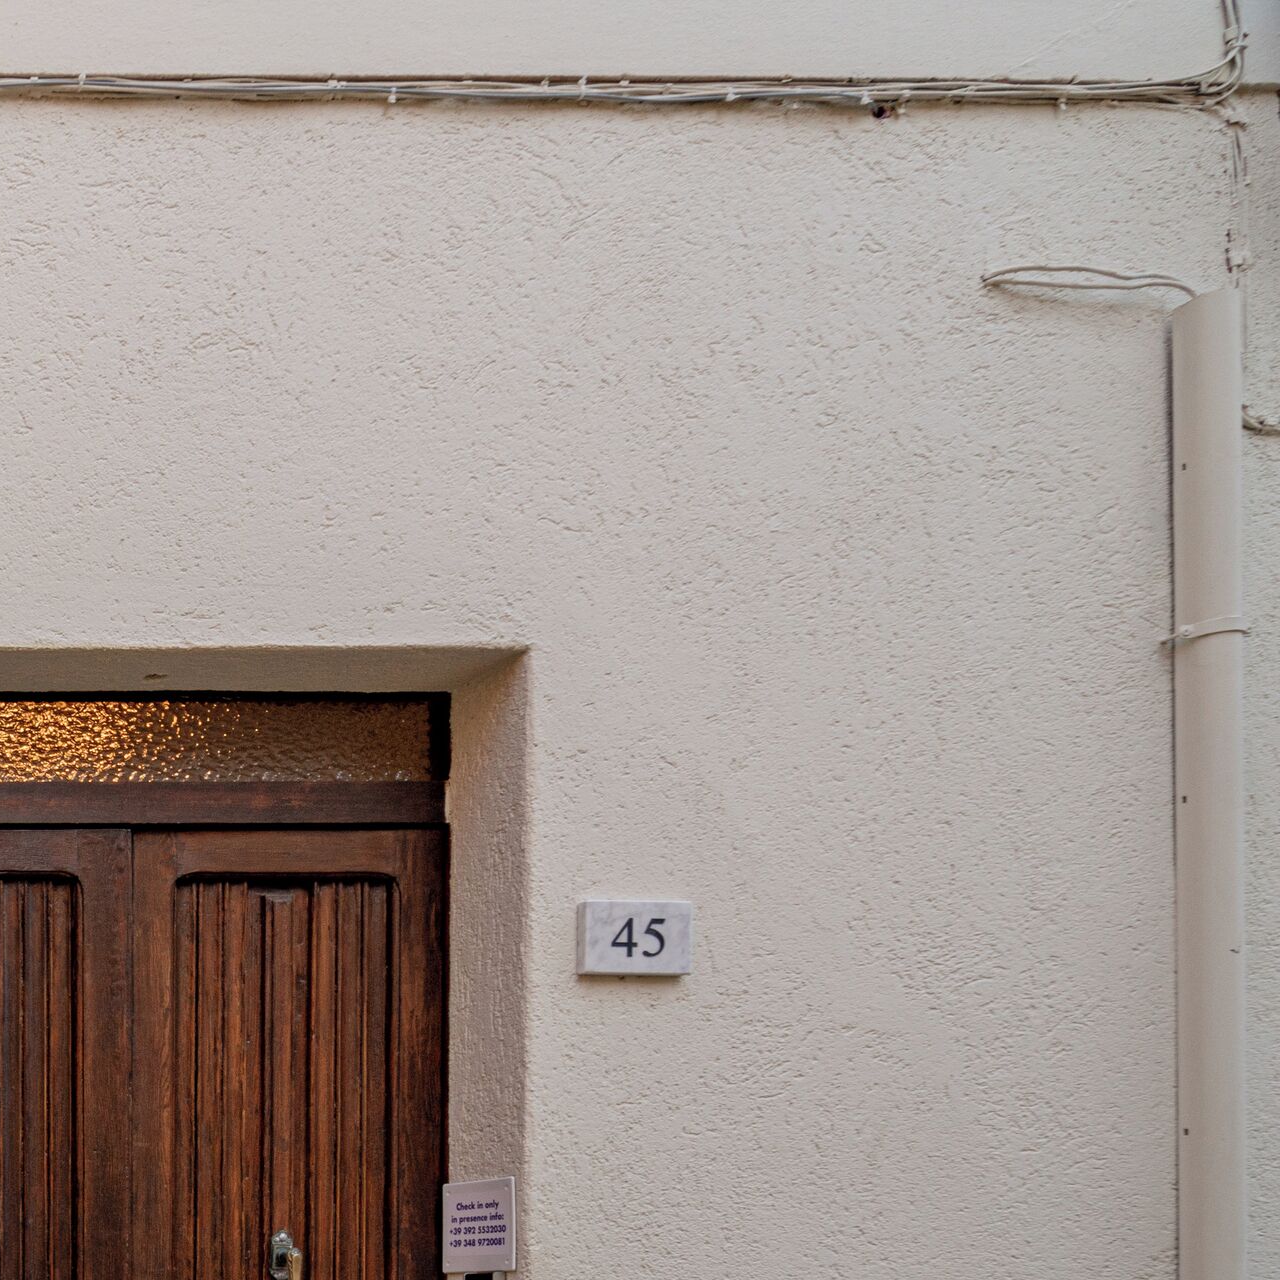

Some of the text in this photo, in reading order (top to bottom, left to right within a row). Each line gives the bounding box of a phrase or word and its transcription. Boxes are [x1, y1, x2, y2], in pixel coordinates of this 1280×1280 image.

[610, 917, 666, 958] 45
[456, 1200, 499, 1211] Check in only
[451, 1212, 505, 1224] in presence info:
[449, 1225, 506, 1235] +39 392 5532030
[449, 1237, 505, 1248] +39 348 9720081
